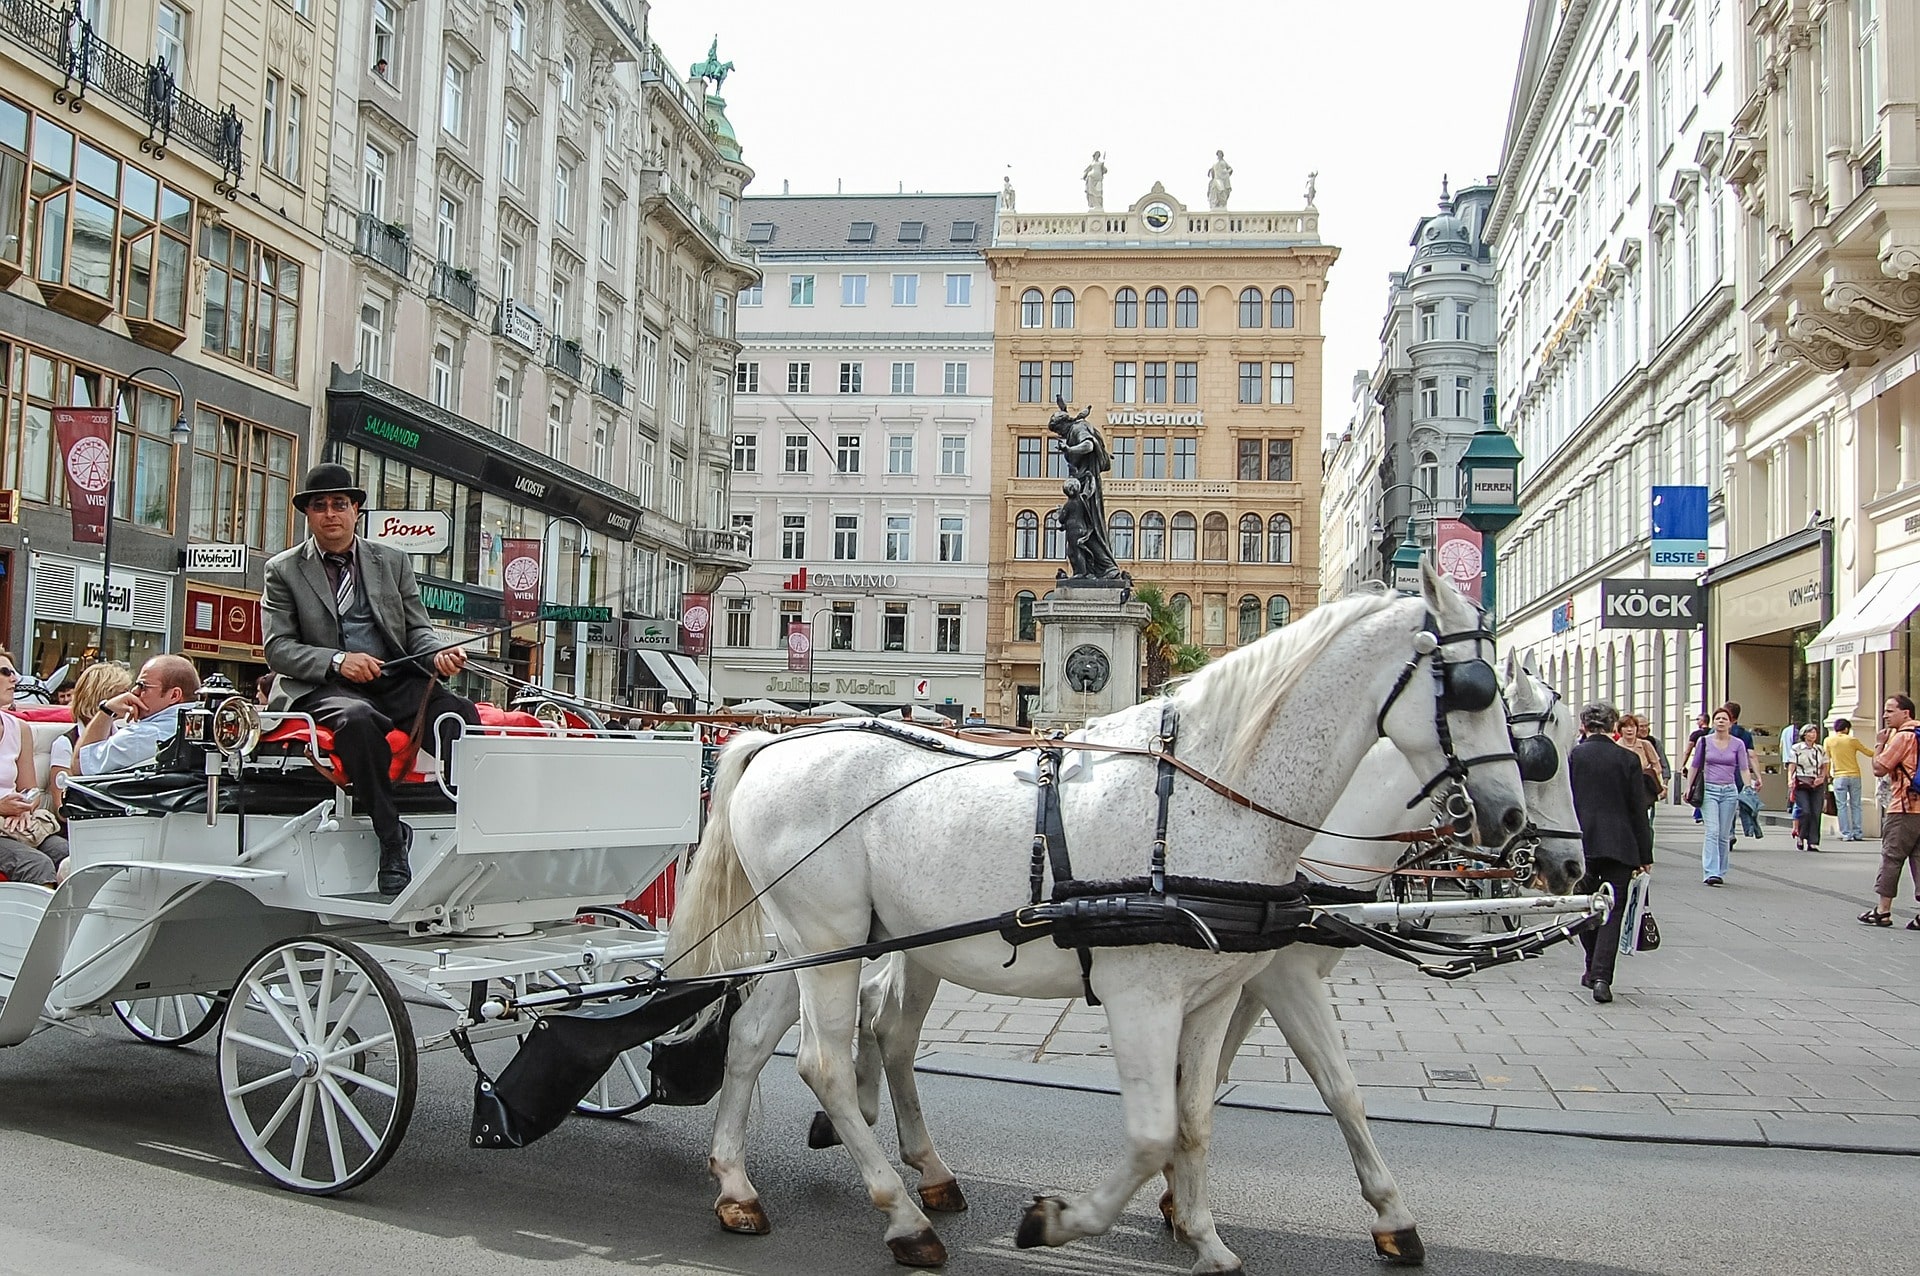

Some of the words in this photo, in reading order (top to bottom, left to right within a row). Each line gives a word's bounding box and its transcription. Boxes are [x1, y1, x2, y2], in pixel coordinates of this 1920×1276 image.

[505, 298, 513, 334] PENSION
[1106, 407, 1204, 426] wüstenrot
[364, 415, 420, 449] SALAMANDER
[515, 475, 546, 498] LACOSTE
[1474, 482, 1512, 492] HERREN
[378, 517, 436, 537] Sioux
[607, 512, 632, 531] LACOSTE
[197, 553, 233, 564] Wolford
[1655, 552, 1695, 563] ERSTE
[812, 573, 837, 588] CA
[843, 574, 898, 589] IMMO
[92, 589, 124, 605] Wford
[513, 592, 535, 601] WIEN
[1606, 588, 1693, 617] KÖCK
[1788, 586, 1803, 608] VON
[634, 635, 671, 645] LACOSTE
[766, 676, 831, 693] Julius
[836, 678, 897, 696] Meinl
